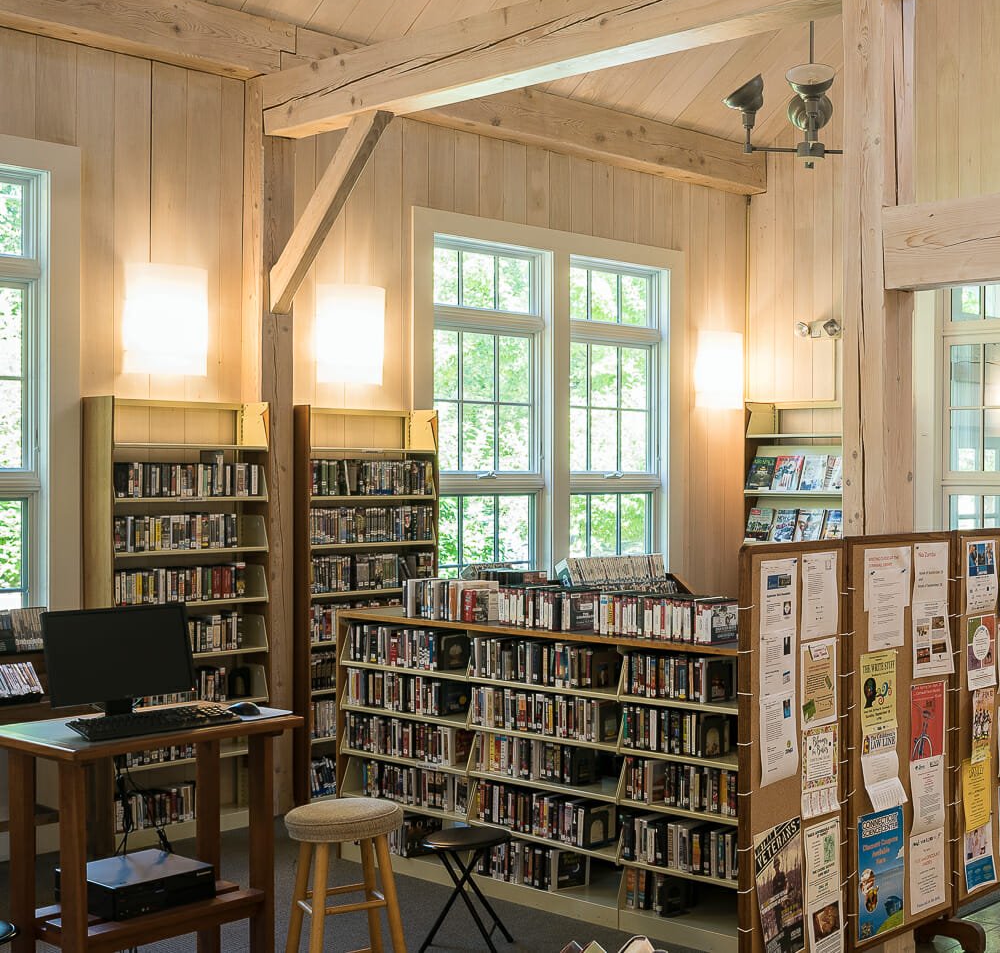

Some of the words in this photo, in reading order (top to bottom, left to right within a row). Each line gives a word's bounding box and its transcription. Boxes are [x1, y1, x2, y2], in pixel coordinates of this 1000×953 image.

[871, 662, 883, 672] WRITE
[870, 739, 881, 750] LAW
[882, 736, 895, 747] LINE
[757, 821, 797, 868] VETERANS
